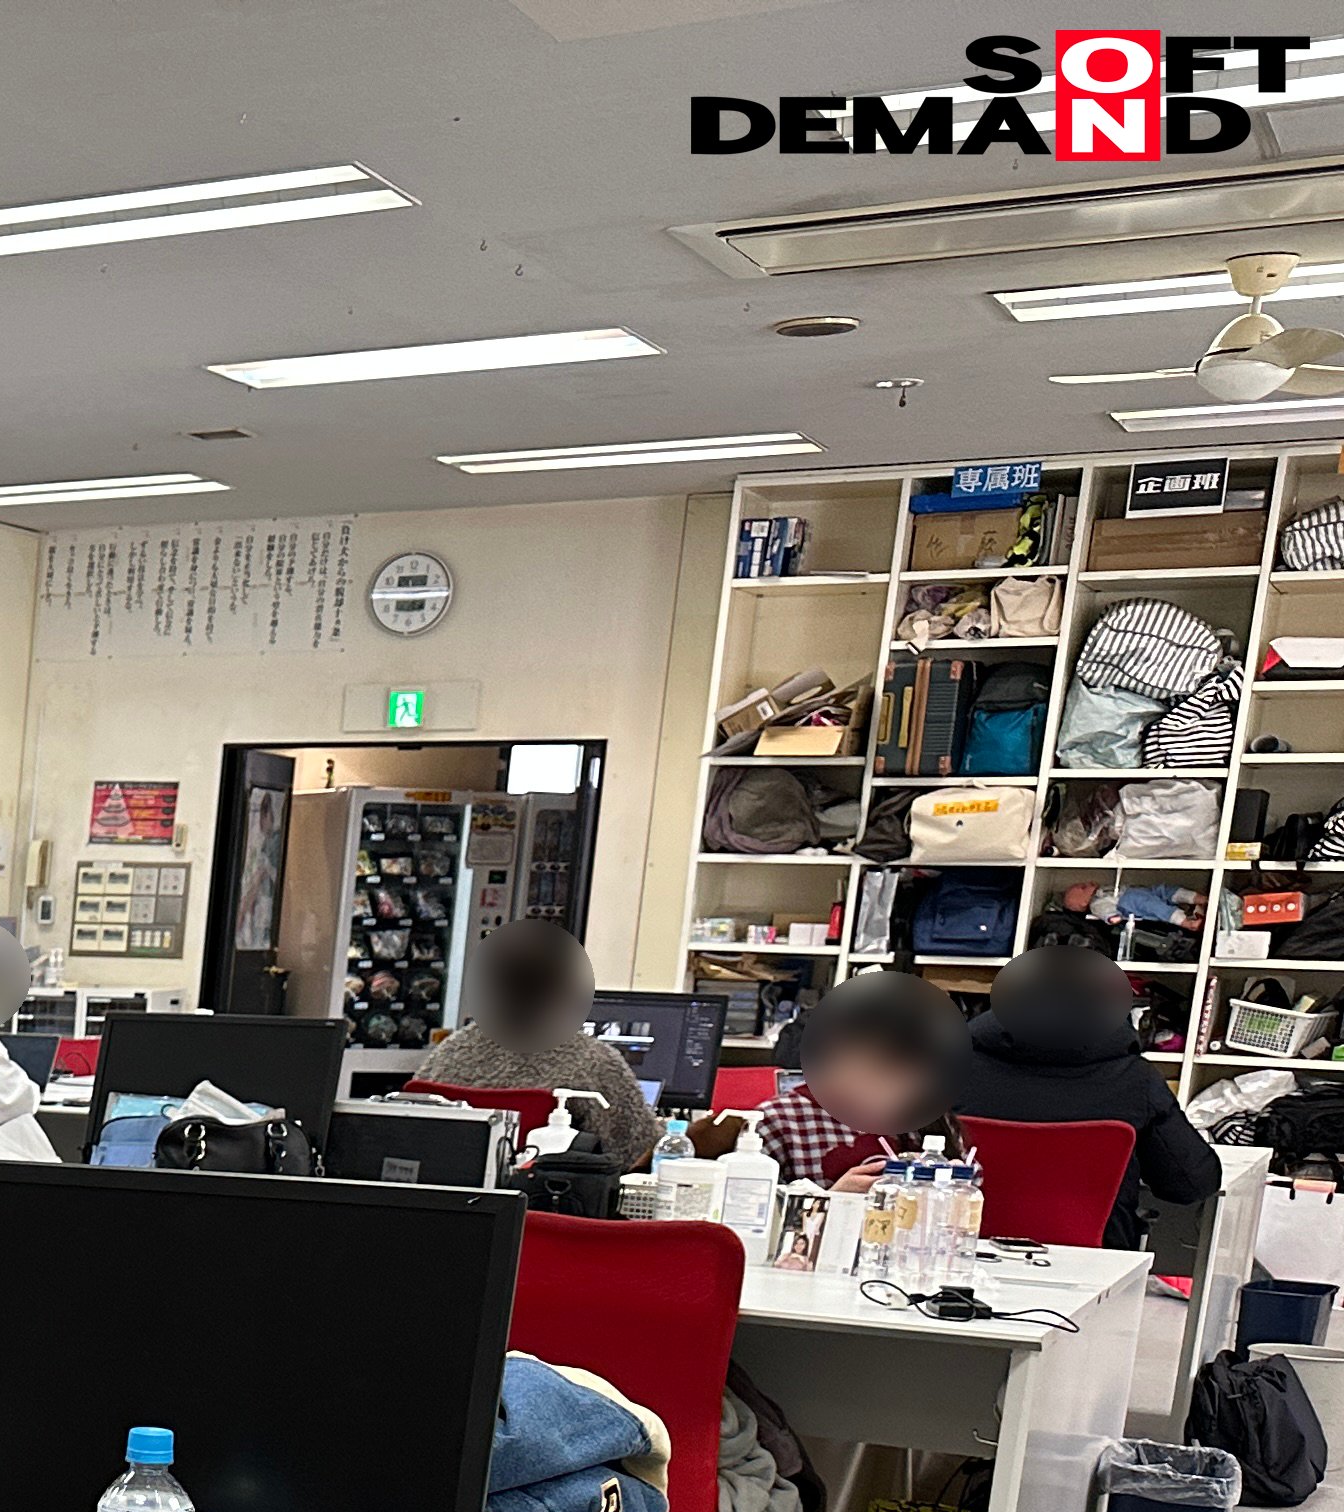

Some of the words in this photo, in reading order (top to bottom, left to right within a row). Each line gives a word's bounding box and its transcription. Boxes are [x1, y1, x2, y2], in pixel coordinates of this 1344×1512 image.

[955, 464, 1040, 491] 専属班
[1135, 473, 1220, 495] 企画班
